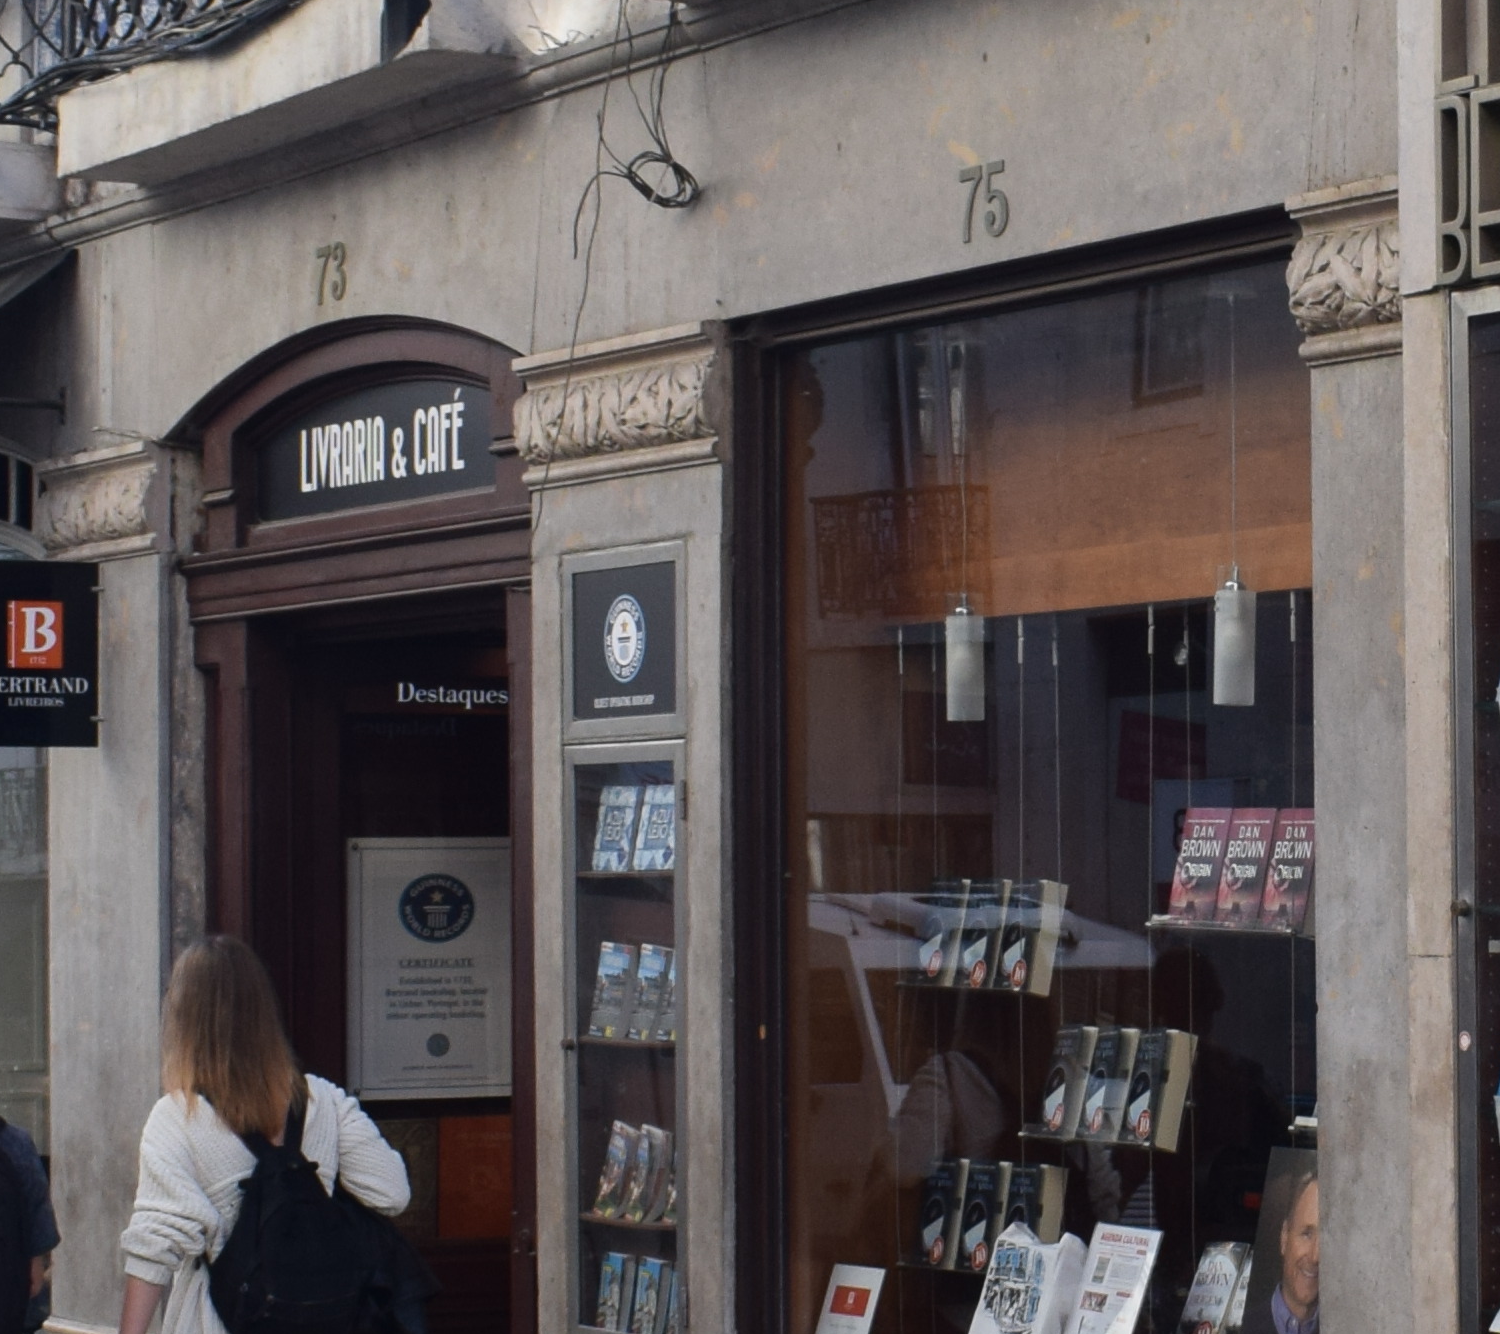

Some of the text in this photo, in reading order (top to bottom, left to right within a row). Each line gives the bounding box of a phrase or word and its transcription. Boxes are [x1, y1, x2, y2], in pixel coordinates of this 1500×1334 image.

[959, 160, 1010, 244] 75
[315, 242, 348, 306] 73
[300, 388, 466, 494] LIVRARIA & CAFÉ
[21, 607, 57, 653] B
[8, 697, 65, 707] LIVREIROS
[397, 681, 509, 709] Destaques
[1193, 825, 1215, 838] DAN
[1239, 826, 1260, 838] DAN
[1181, 840, 1221, 857] BROWN
[1227, 841, 1266, 858] BROWN
